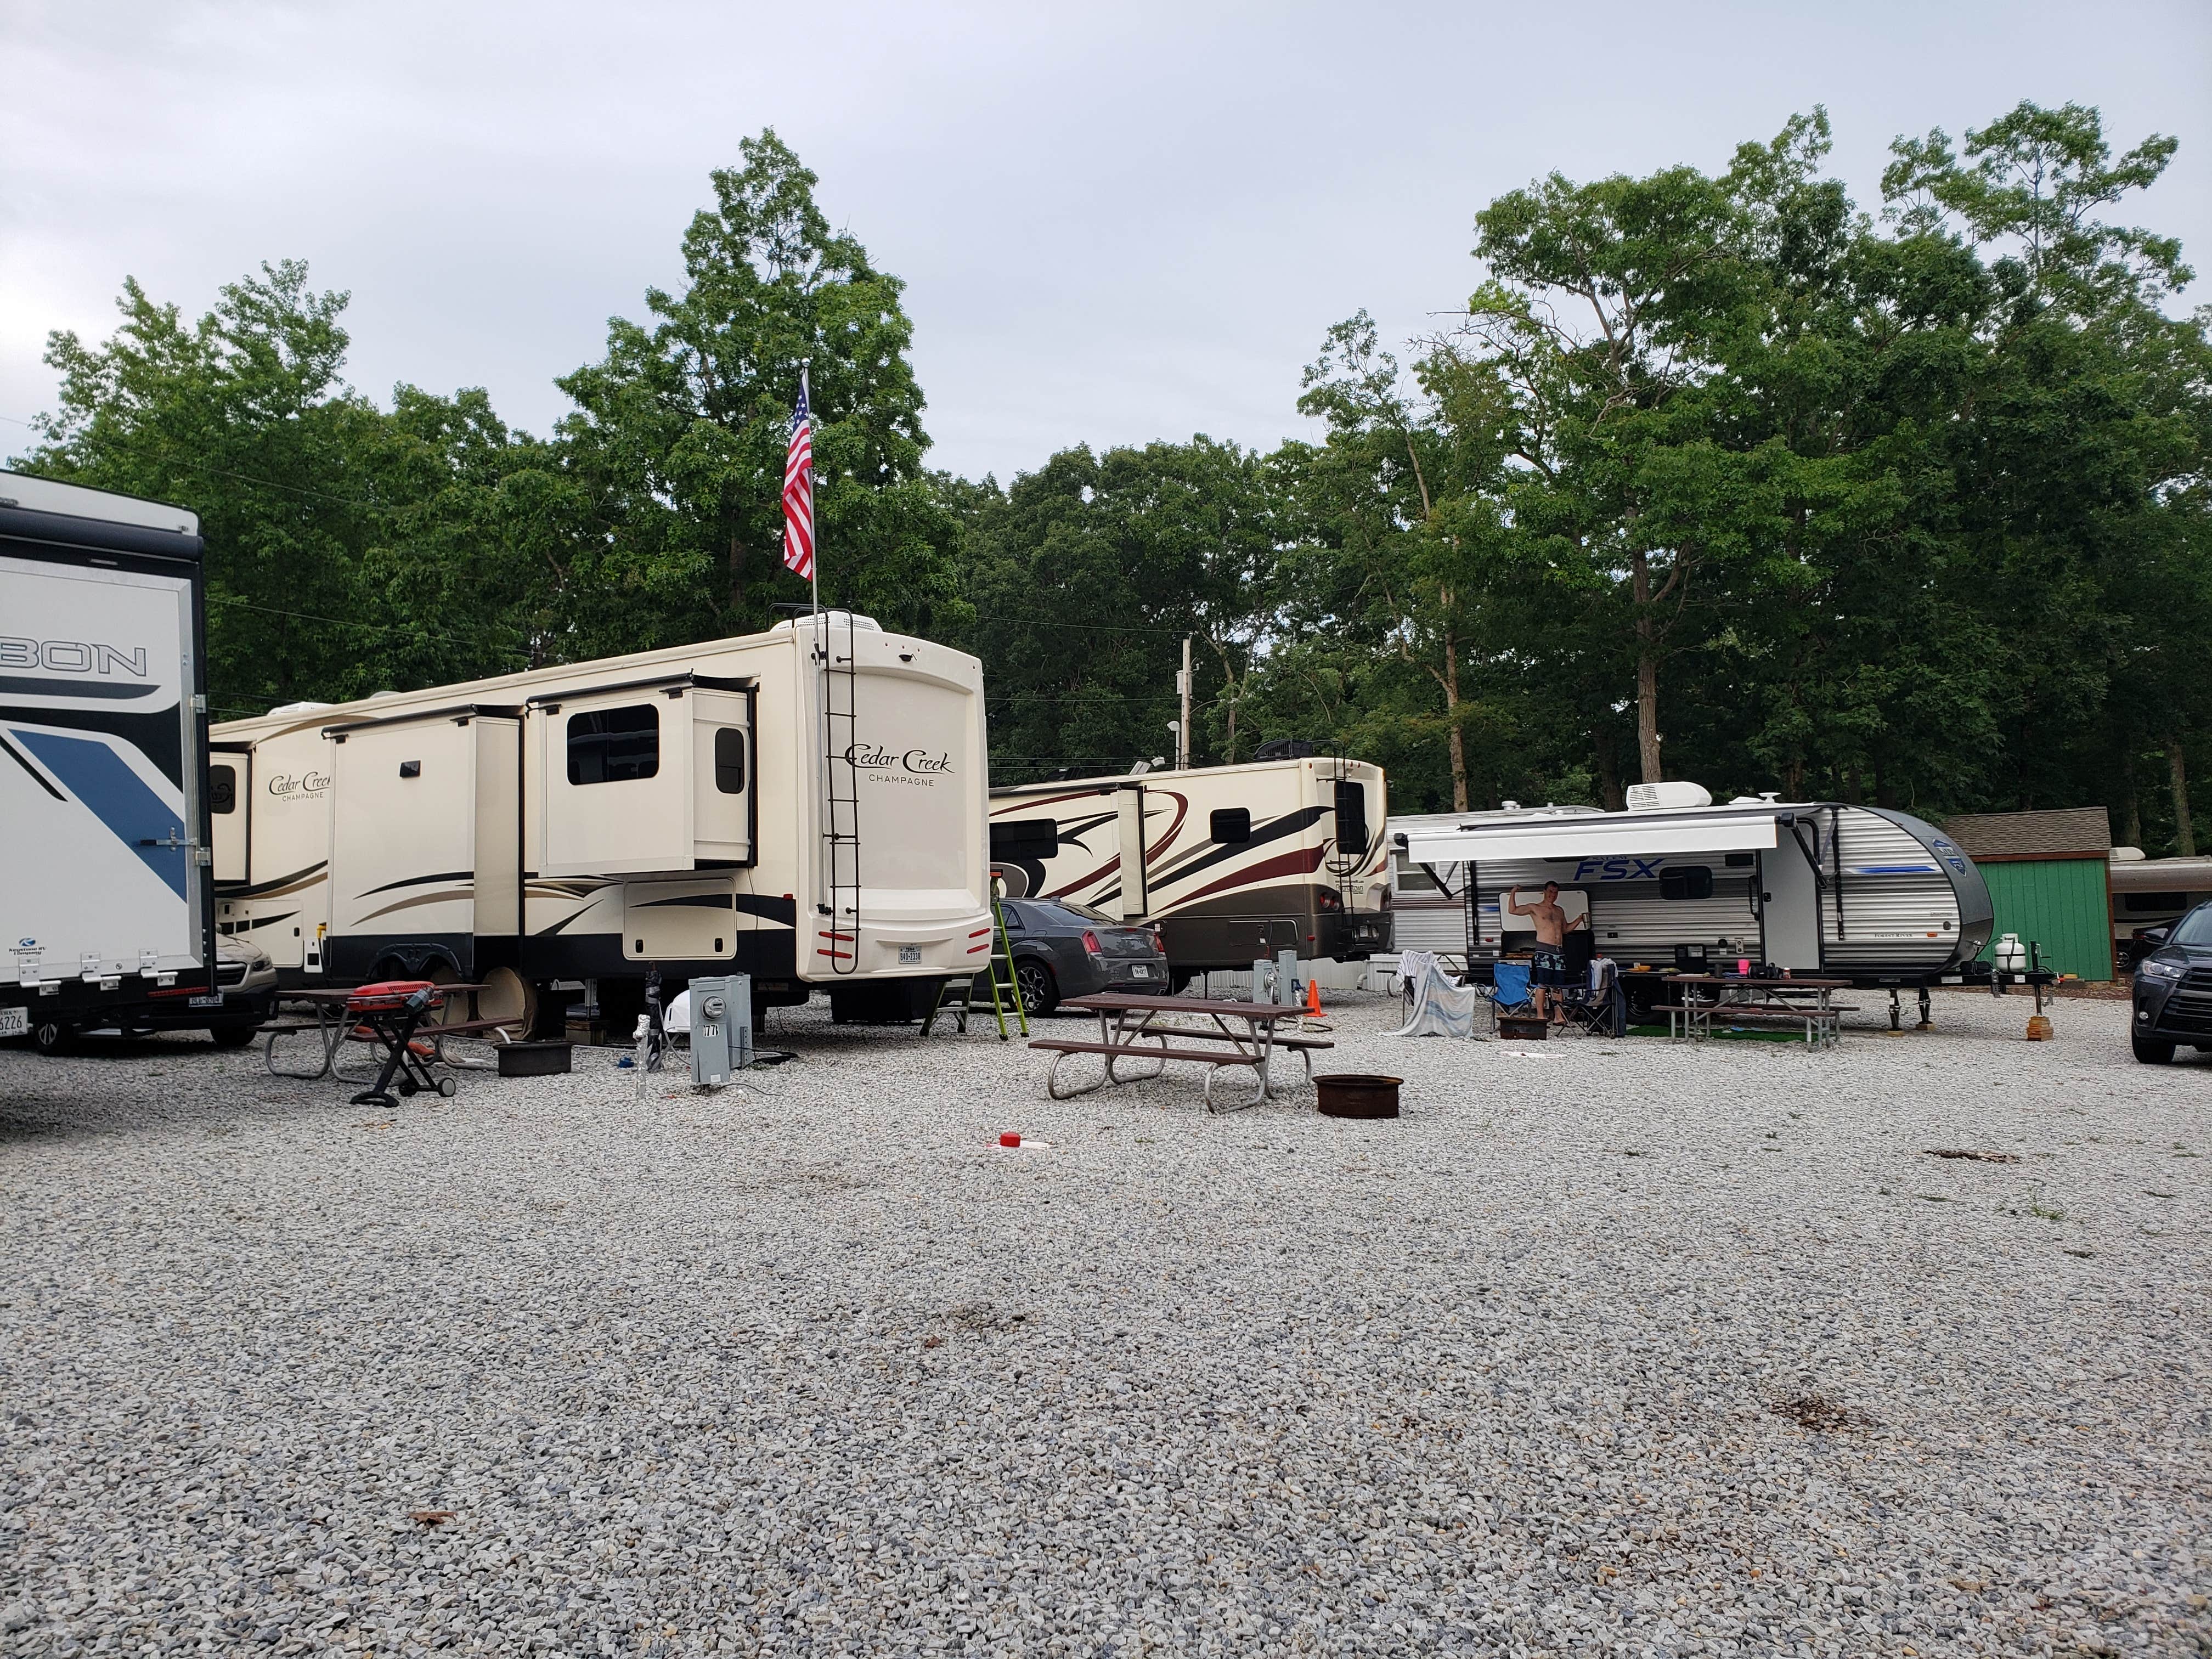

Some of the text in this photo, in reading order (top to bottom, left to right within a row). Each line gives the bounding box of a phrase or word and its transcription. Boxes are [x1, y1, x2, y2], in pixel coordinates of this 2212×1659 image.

[844, 743, 956, 775] Cedar Creek
[269, 774, 300, 795] Cedar
[869, 774, 934, 787] CHAMPAGNE
[282, 792, 324, 802] CHAMPAGNE
[1573, 858, 1666, 881] FSX
